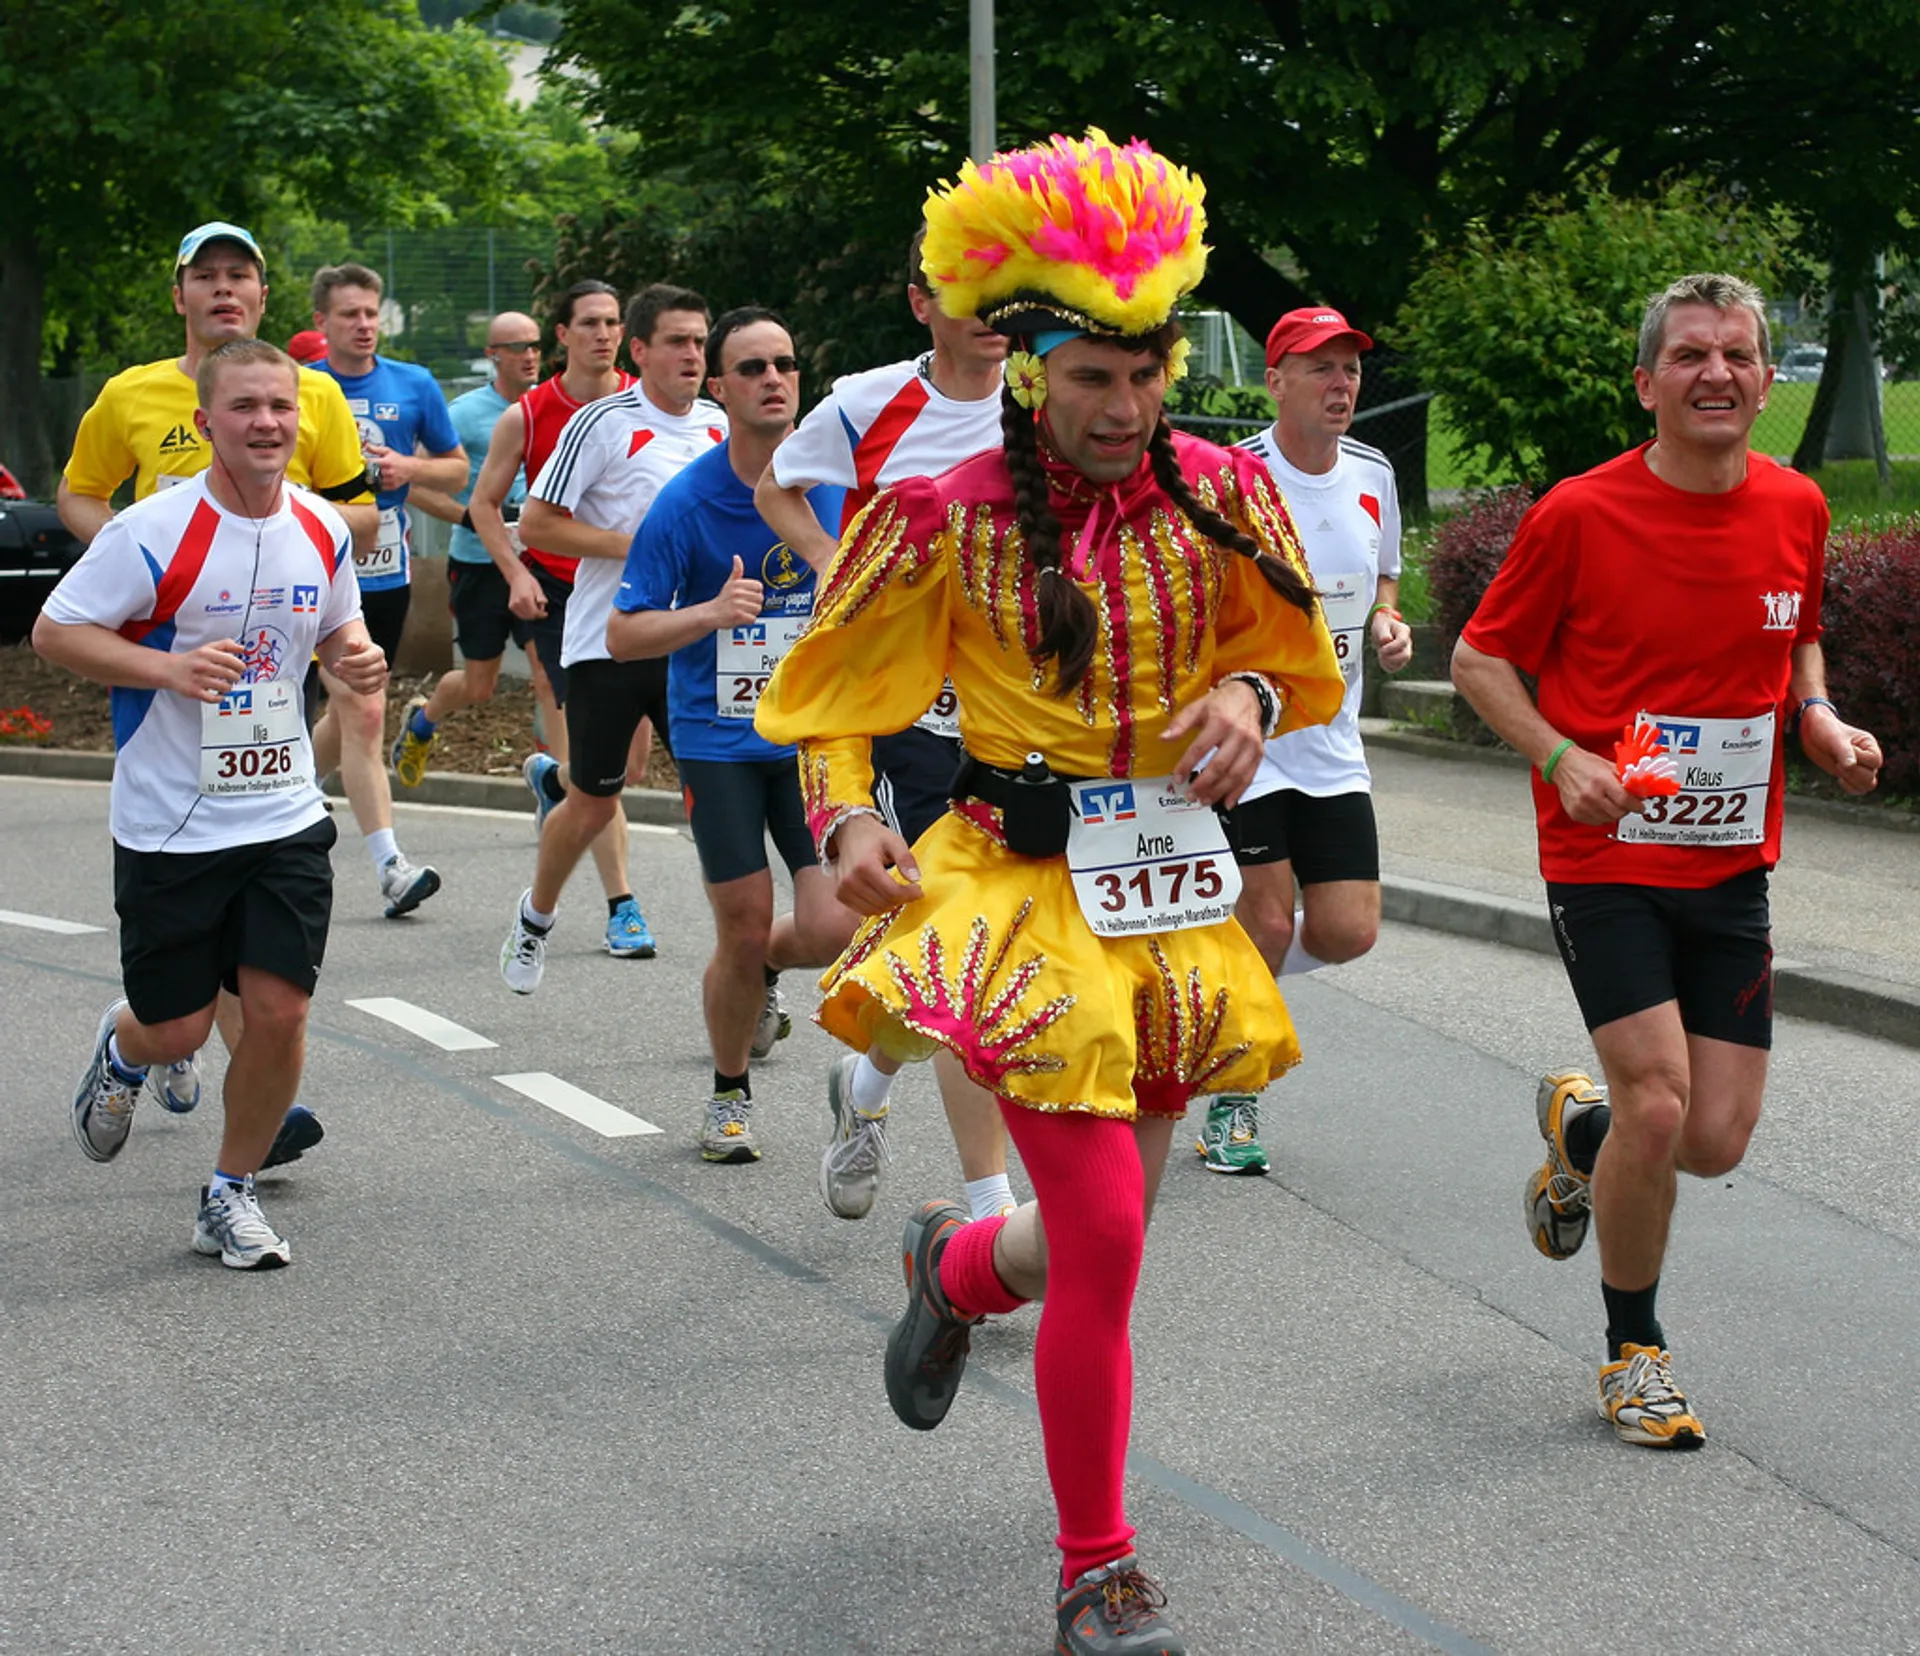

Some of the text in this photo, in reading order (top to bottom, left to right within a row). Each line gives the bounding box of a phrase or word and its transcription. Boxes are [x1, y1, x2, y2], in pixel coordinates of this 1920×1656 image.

[253, 724, 269, 745] Ilja
[1721, 739, 1763, 750] Ensinger
[218, 745, 292, 778] 3026
[1685, 767, 1723, 786] Klaus
[1643, 793, 1748, 826] 3222
[1136, 833, 1174, 858] Arne
[1095, 859, 1223, 913] 3175
